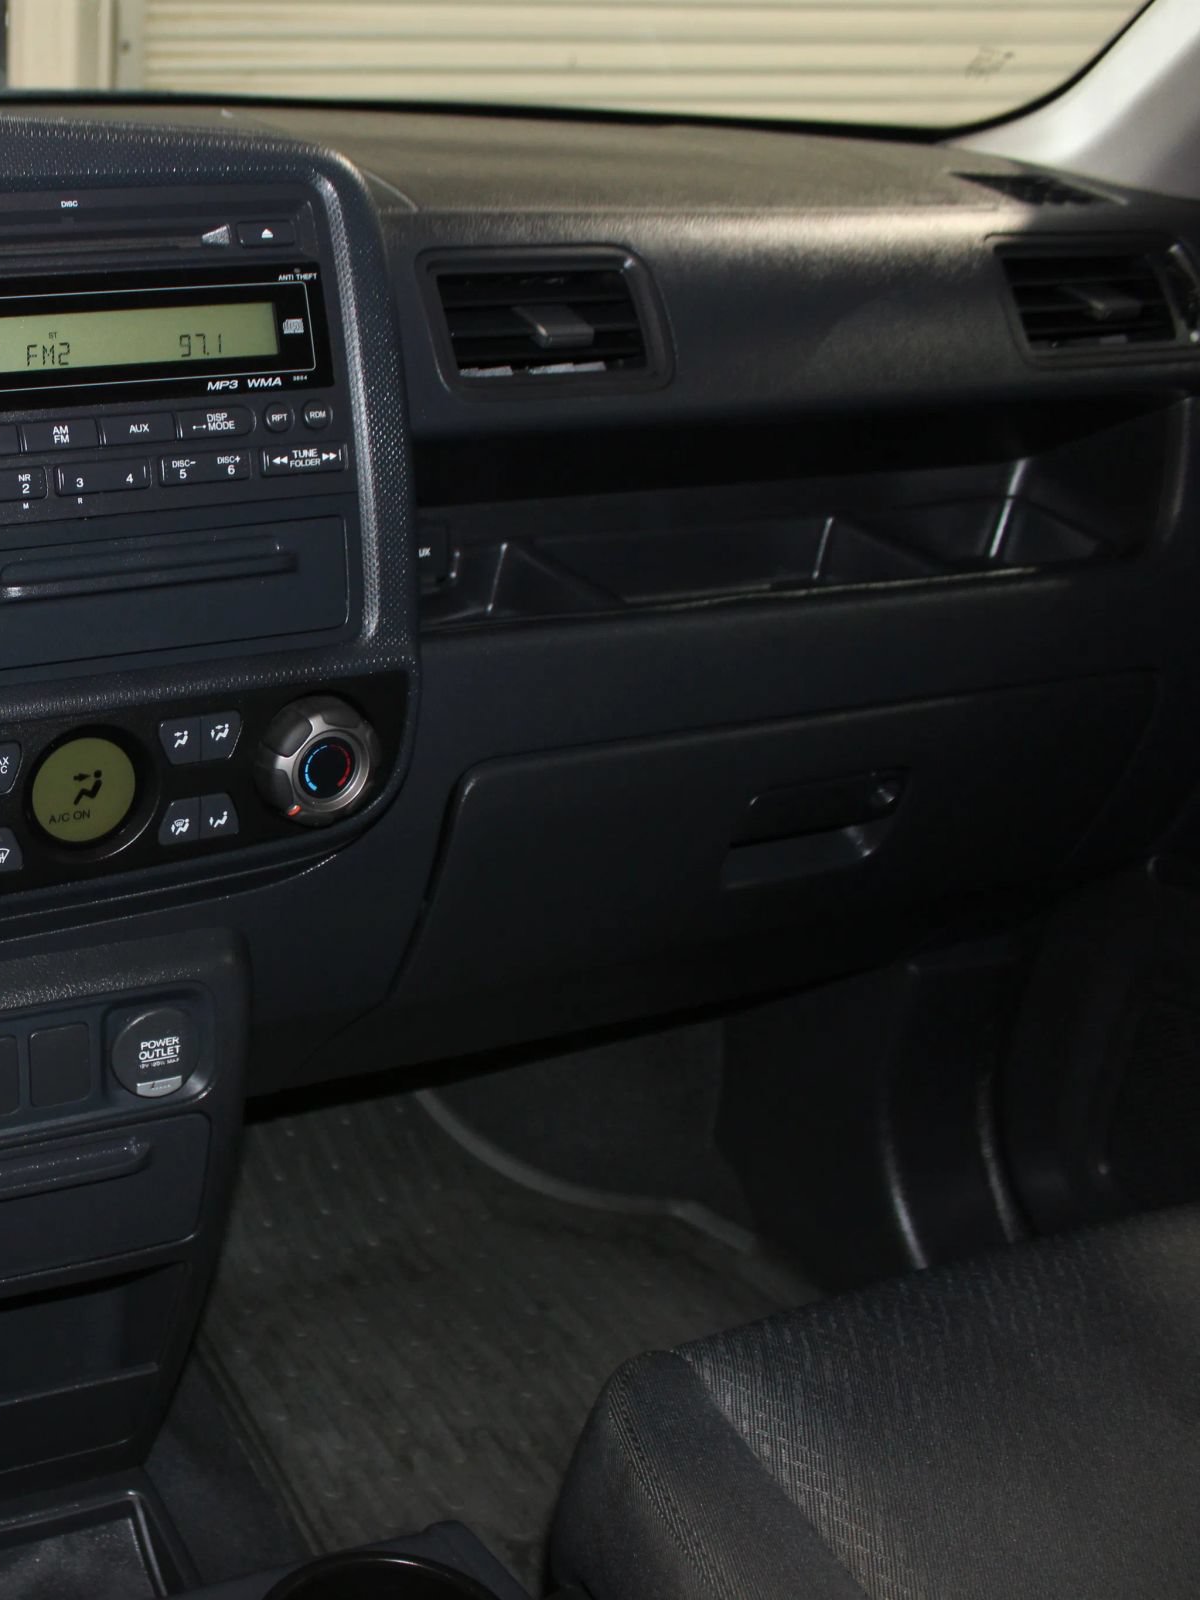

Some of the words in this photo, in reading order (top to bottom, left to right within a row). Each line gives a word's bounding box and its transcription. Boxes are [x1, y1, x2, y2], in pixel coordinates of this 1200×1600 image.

[296, 272, 317, 280] THEFT
[26, 342, 71, 367] FM2
[179, 333, 222, 358] 97.1
[207, 379, 239, 391] MP3
[247, 376, 282, 388] WMA
[206, 412, 228, 423] DISP
[271, 413, 288, 422] RPT
[310, 410, 326, 419] RDM
[52, 425, 68, 435] AM
[129, 423, 150, 433] AUX
[208, 420, 235, 431] MODE
[53, 434, 70, 444] FM
[292, 448, 318, 459] TUNE
[290, 458, 321, 468] FOLDER
[179, 468, 187, 479] 5
[227, 465, 235, 475] 6
[18, 474, 31, 482] NR
[76, 478, 84, 488] 3
[126, 473, 134, 484] 4
[22, 484, 30, 494] 2
[22, 502, 29, 510] M
[77, 497, 83, 505] R
[418, 547, 431, 558] UX
[49, 812, 70, 824] A/C
[73, 809, 90, 820] ON
[141, 1036, 180, 1051] POWER
[139, 1045, 181, 1060] OUTLET
